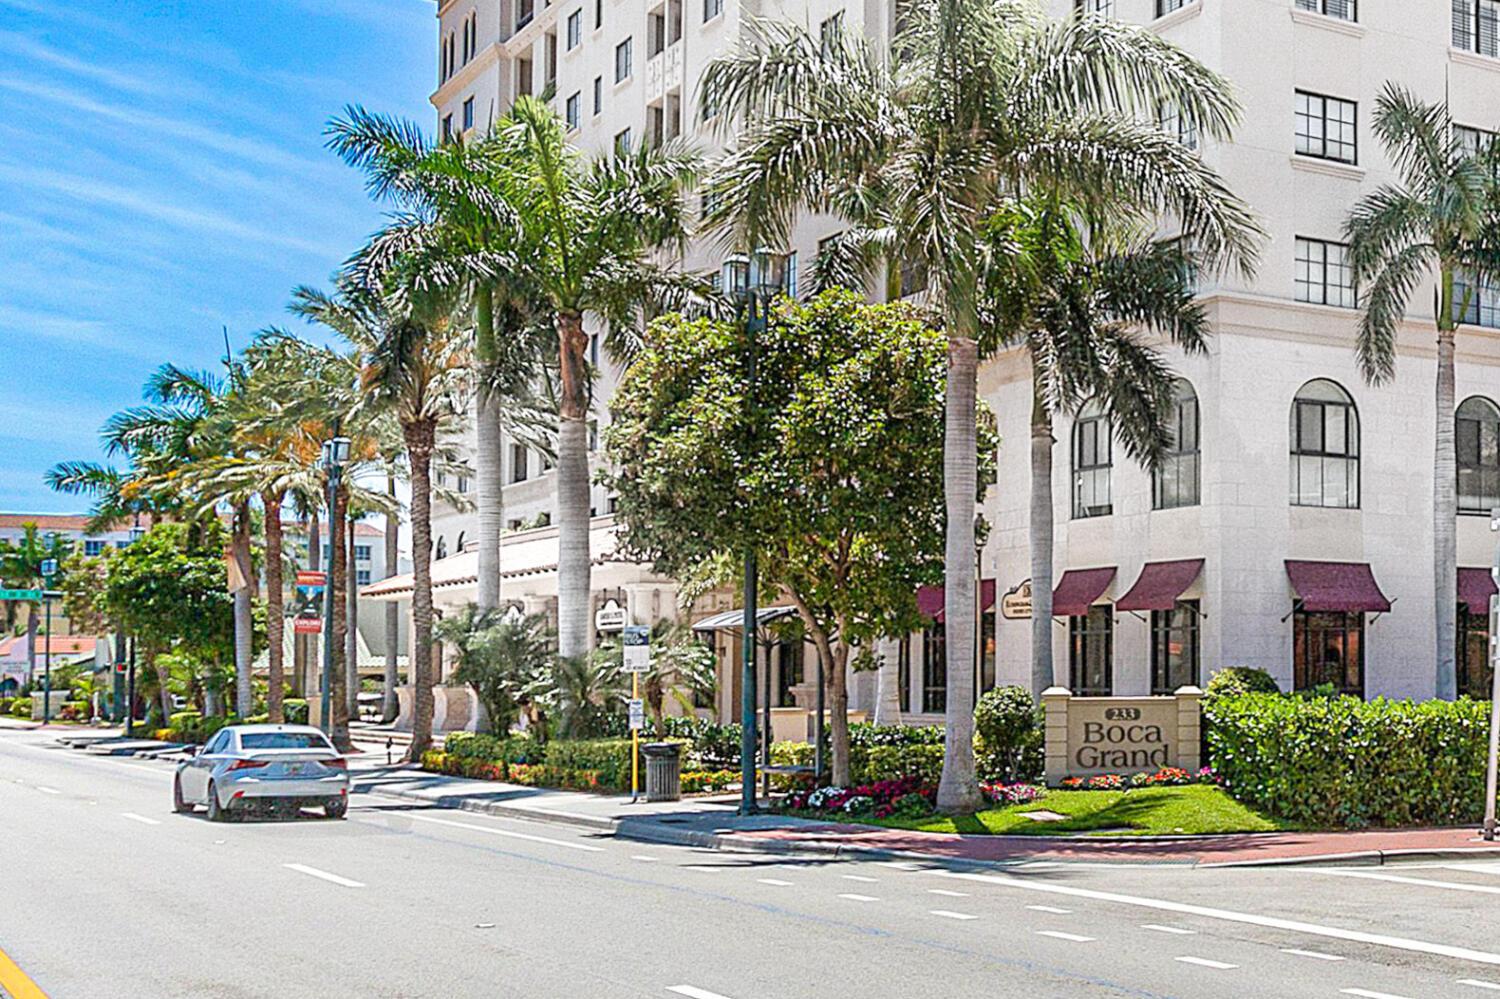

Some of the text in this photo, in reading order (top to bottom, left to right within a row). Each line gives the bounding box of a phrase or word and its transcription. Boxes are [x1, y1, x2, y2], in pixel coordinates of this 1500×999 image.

[1111, 708, 1136, 720] 233
[1084, 722, 1161, 743] Boca
[1076, 744, 1169, 768] Grand
